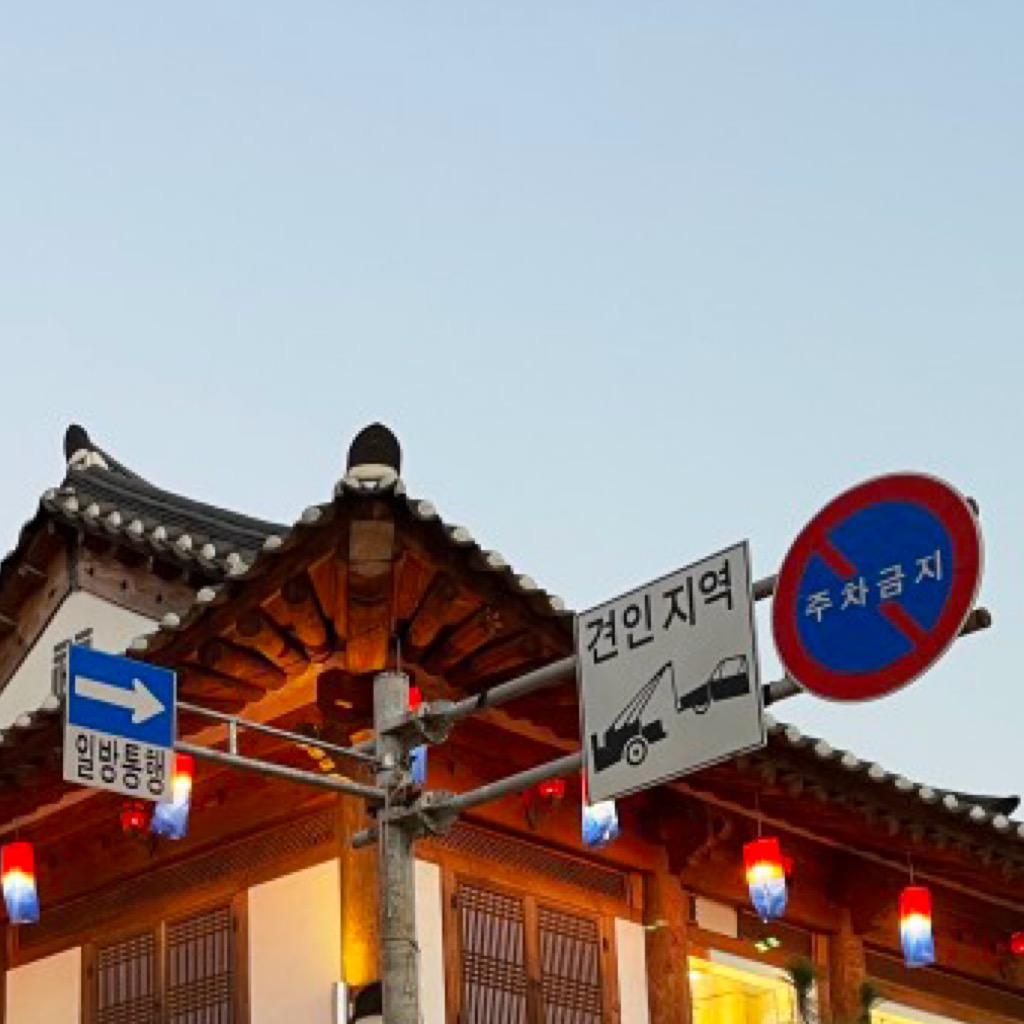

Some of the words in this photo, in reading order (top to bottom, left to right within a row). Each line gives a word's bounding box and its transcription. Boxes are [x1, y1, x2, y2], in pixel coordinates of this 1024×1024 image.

[586, 558, 734, 664] 견인지역
[805, 549, 942, 622] 주차금지
[76, 733, 165, 796] 일방통행
